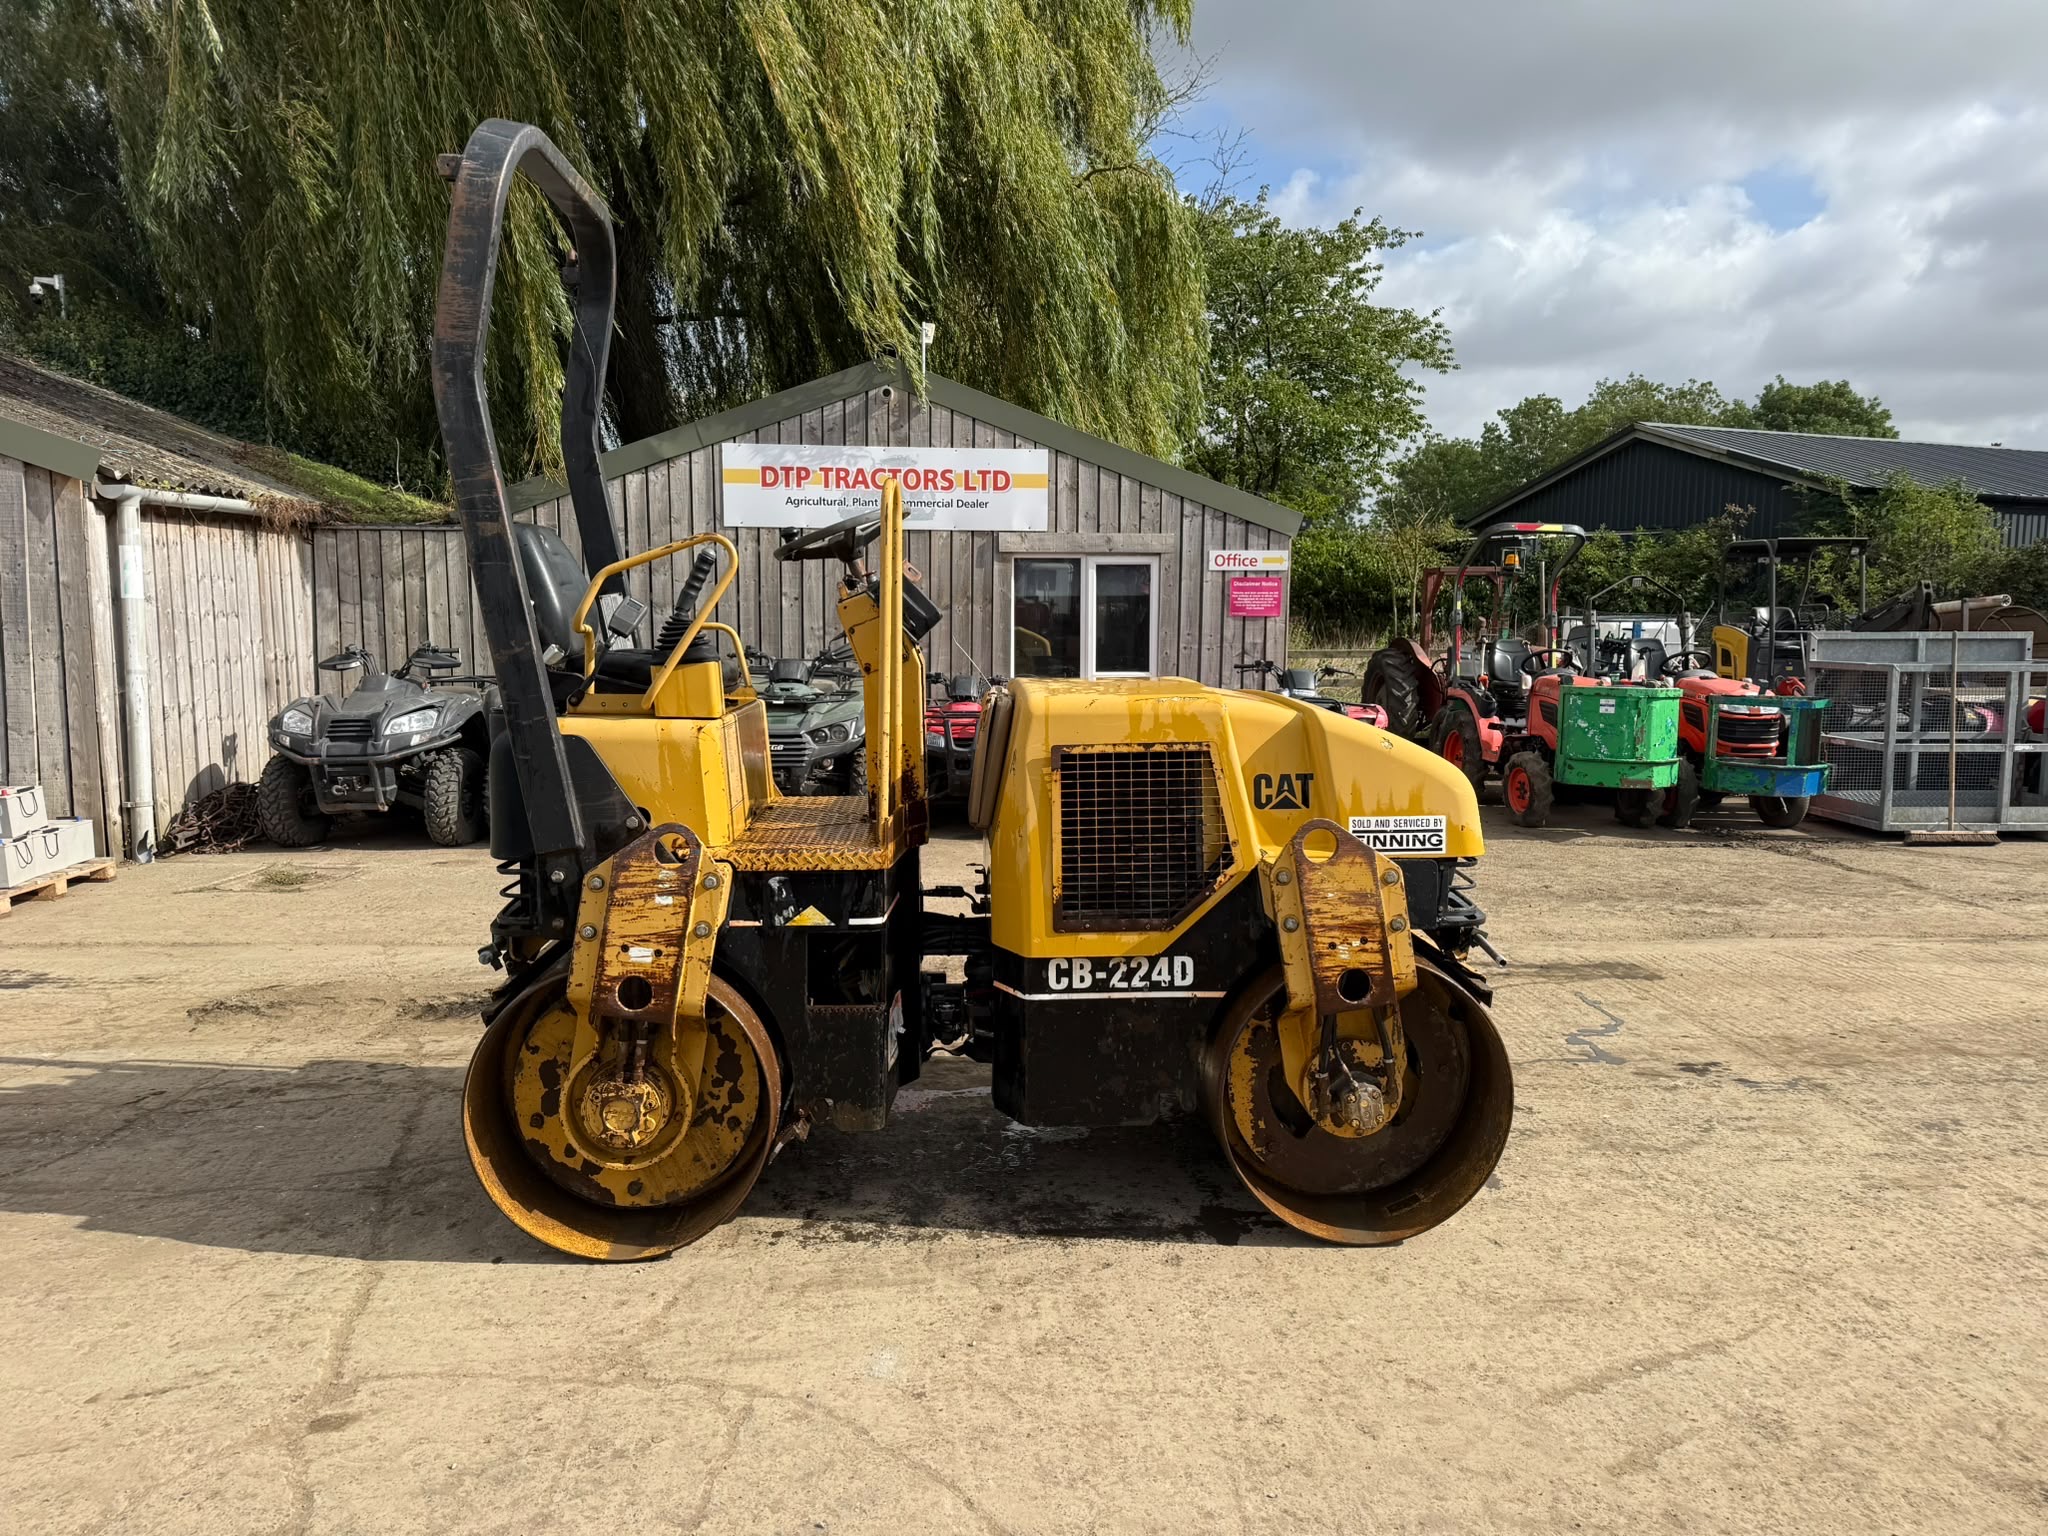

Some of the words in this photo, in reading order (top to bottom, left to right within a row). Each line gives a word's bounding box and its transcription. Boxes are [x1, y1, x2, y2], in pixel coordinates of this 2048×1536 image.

[761, 466, 811, 488] DTP
[819, 468, 955, 491] TRACTORS
[964, 470, 1011, 492] LTD
[785, 496, 849, 508] Agricultural,
[852, 497, 878, 507] Plant
[901, 499, 953, 508] mmercial
[956, 499, 989, 509] Dealer
[1214, 553, 1258, 567] Office
[1253, 773, 1314, 809] CAT
[1352, 819, 1371, 829] SOLD
[1374, 819, 1390, 828] AND
[1393, 818, 1430, 828] SERVICED
[1433, 818, 1443, 828] BY
[1048, 955, 1195, 990] CB-224D
